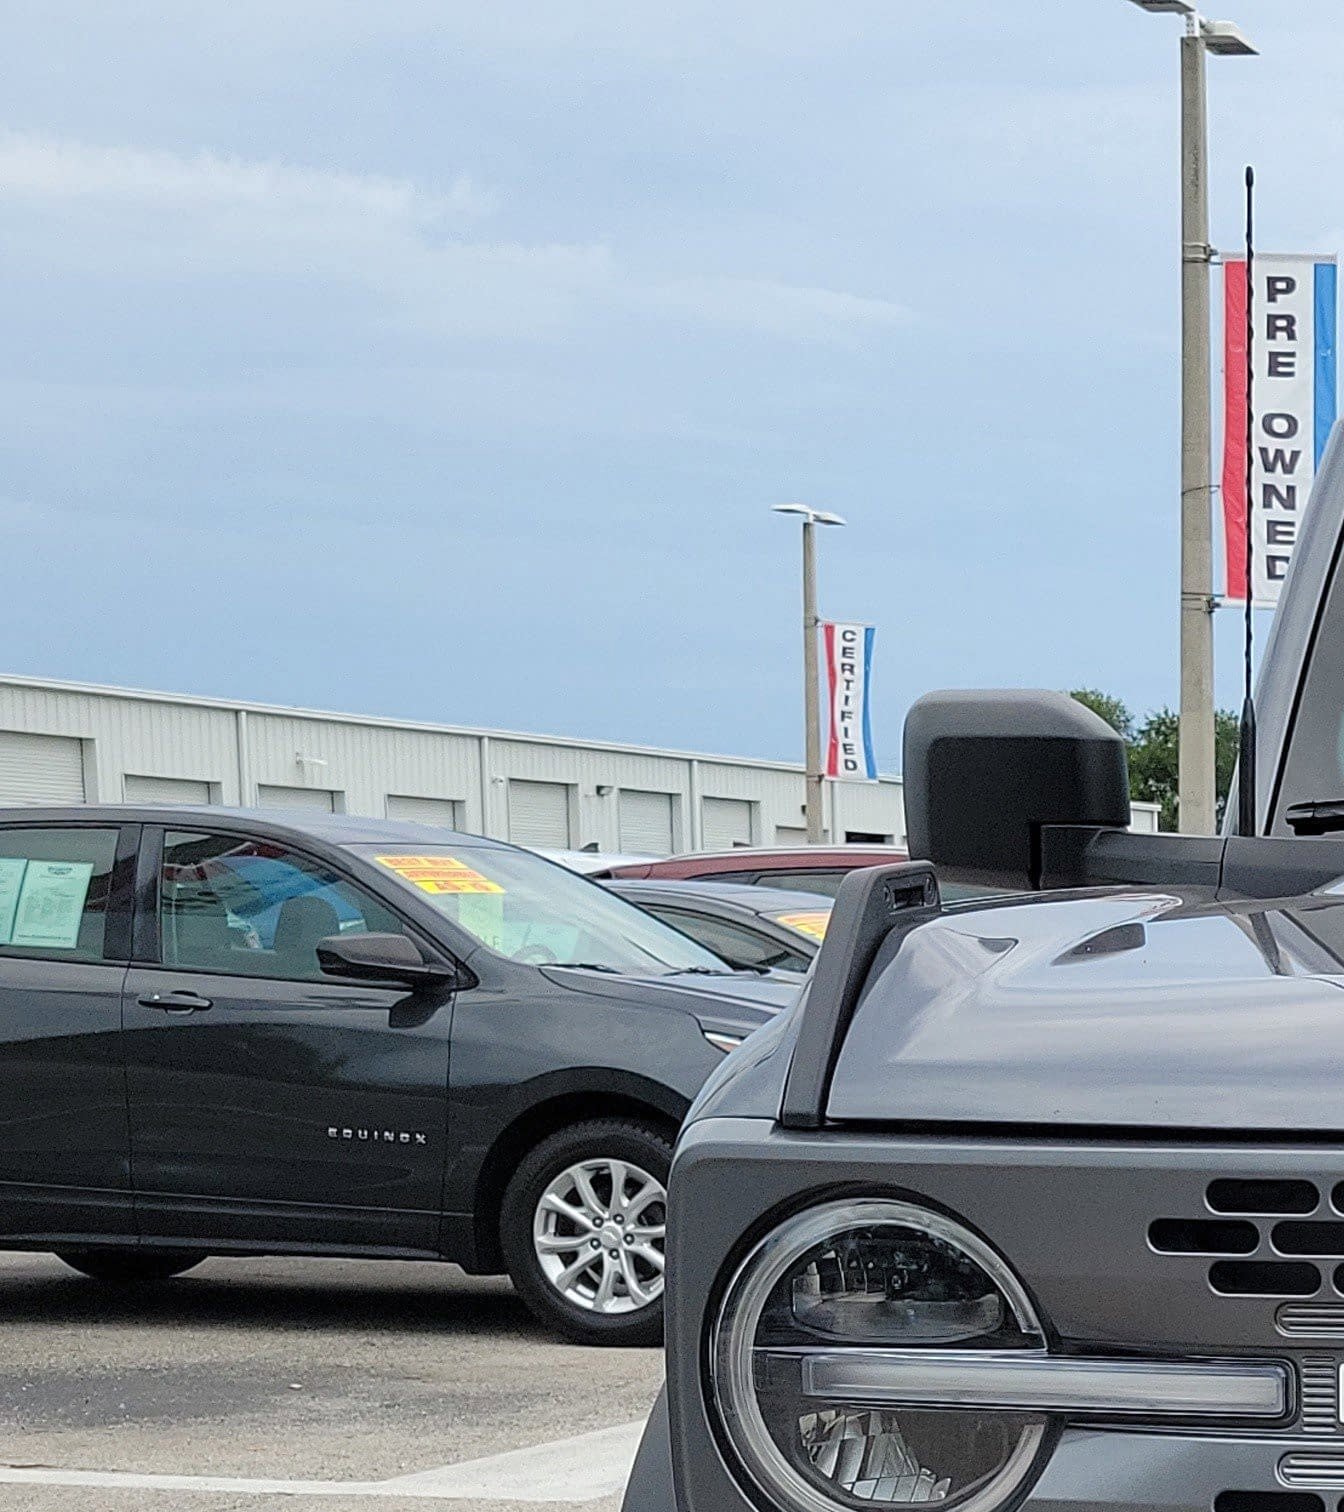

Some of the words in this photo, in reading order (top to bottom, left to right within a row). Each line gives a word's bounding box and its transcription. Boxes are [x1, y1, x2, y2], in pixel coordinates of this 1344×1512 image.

[1266, 275, 1297, 378] PRE
[1259, 413, 1301, 580] OWNED
[841, 630, 858, 771] CERTIFIED
[328, 1127, 426, 1143] EQUINOX
